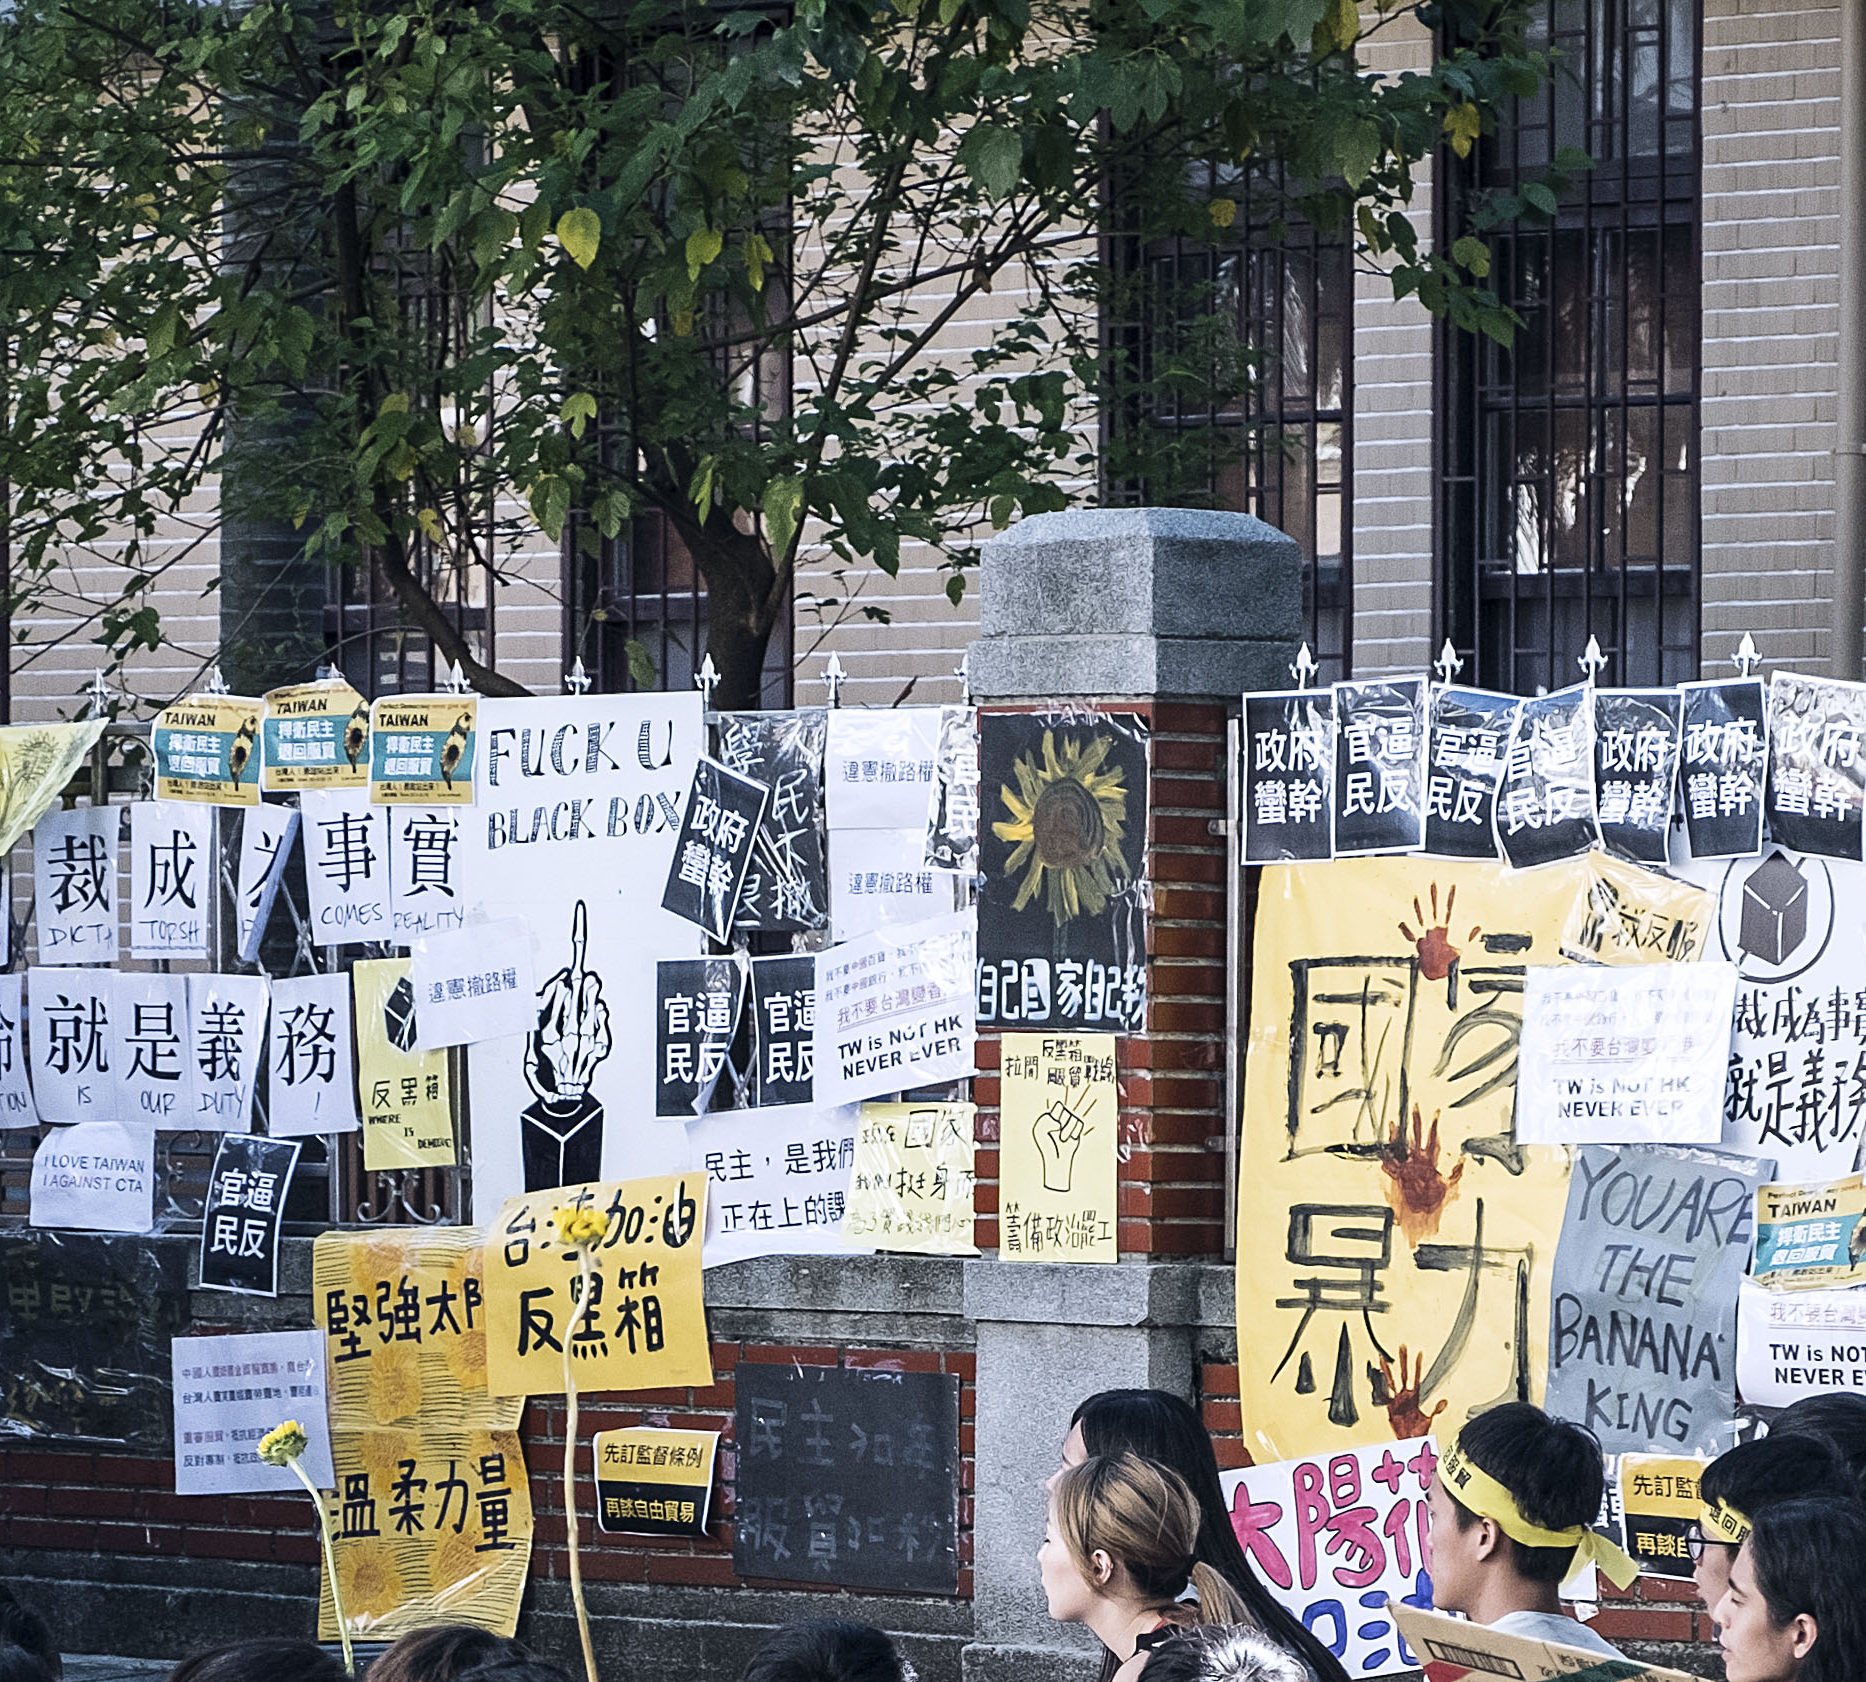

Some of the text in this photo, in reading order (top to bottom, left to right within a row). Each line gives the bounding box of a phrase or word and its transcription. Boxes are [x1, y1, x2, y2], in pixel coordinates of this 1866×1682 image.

[165, 711, 217, 727] TAIWAN
[276, 698, 328, 715] TAIWAN
[379, 713, 429, 728] TAIWAN
[489, 719, 674, 788] FUCK U
[1254, 730, 1322, 772] 政府
[1346, 718, 1414, 762] 官逼
[1433, 727, 1505, 775] 官逼
[1506, 723, 1581, 780] 官逼
[1600, 727, 1671, 771] 政府
[1687, 717, 1758, 763] 政府
[1778, 717, 1864, 767] 政府
[1342, 773, 1410, 818] 民反
[1427, 776, 1486, 826] 民反
[1506, 787, 1580, 836] 民反
[488, 790, 683, 851] BLACK BOX
[690, 798, 750, 854] 政府
[48, 835, 110, 914] 裁
[144, 830, 198, 910] 成
[317, 813, 376, 892] 事
[403, 813, 460, 898] 實
[321, 902, 384, 926] COMES
[393, 905, 466, 931] REALITY
[44, 994, 110, 1075] 就
[664, 992, 733, 1037] 官逼
[126, 1003, 182, 1081] 是
[197, 1002, 245, 1083] 義
[275, 1002, 337, 1086] 務
[838, 1015, 964, 1060] TW is NOT HK
[841, 1037, 963, 1081] NEVER EVER
[663, 1044, 726, 1086] 民反
[1005, 1055, 1039, 1079] 拉開
[1554, 1075, 1693, 1095] TW is NOT HK
[76, 1085, 91, 1105] IS
[140, 1091, 177, 1114] OUR
[198, 1085, 249, 1117] DUTY
[1557, 1099, 1684, 1119] NEVER EVER
[368, 1114, 402, 1126] WHERE
[50, 1174, 111, 1191] AGAINST
[115, 1178, 144, 1193] CTA
[51, 1155, 89, 1170] LOVE
[94, 1155, 145, 1174] TAIWAN
[218, 1167, 280, 1210] 官逼
[1579, 1155, 1676, 1231] YOU
[1768, 1197, 1837, 1218] TAIWAN
[208, 1216, 269, 1261] 民反
[504, 1180, 695, 1268] 台加油
[1778, 1220, 1843, 1248] 捍衛民主
[1599, 1244, 1696, 1307] THE
[517, 1263, 663, 1359] 反黑箱
[1554, 1292, 1721, 1382] BANANA
[1769, 1343, 1800, 1361] TW
[1805, 1344, 1823, 1361] is
[1774, 1367, 1847, 1387] NEVER
[1585, 1378, 1693, 1443] KING
[603, 1442, 703, 1468] 先訂監督條例
[331, 1452, 517, 1554] 溫柔力量
[605, 1498, 695, 1524] 再談自由貿易
